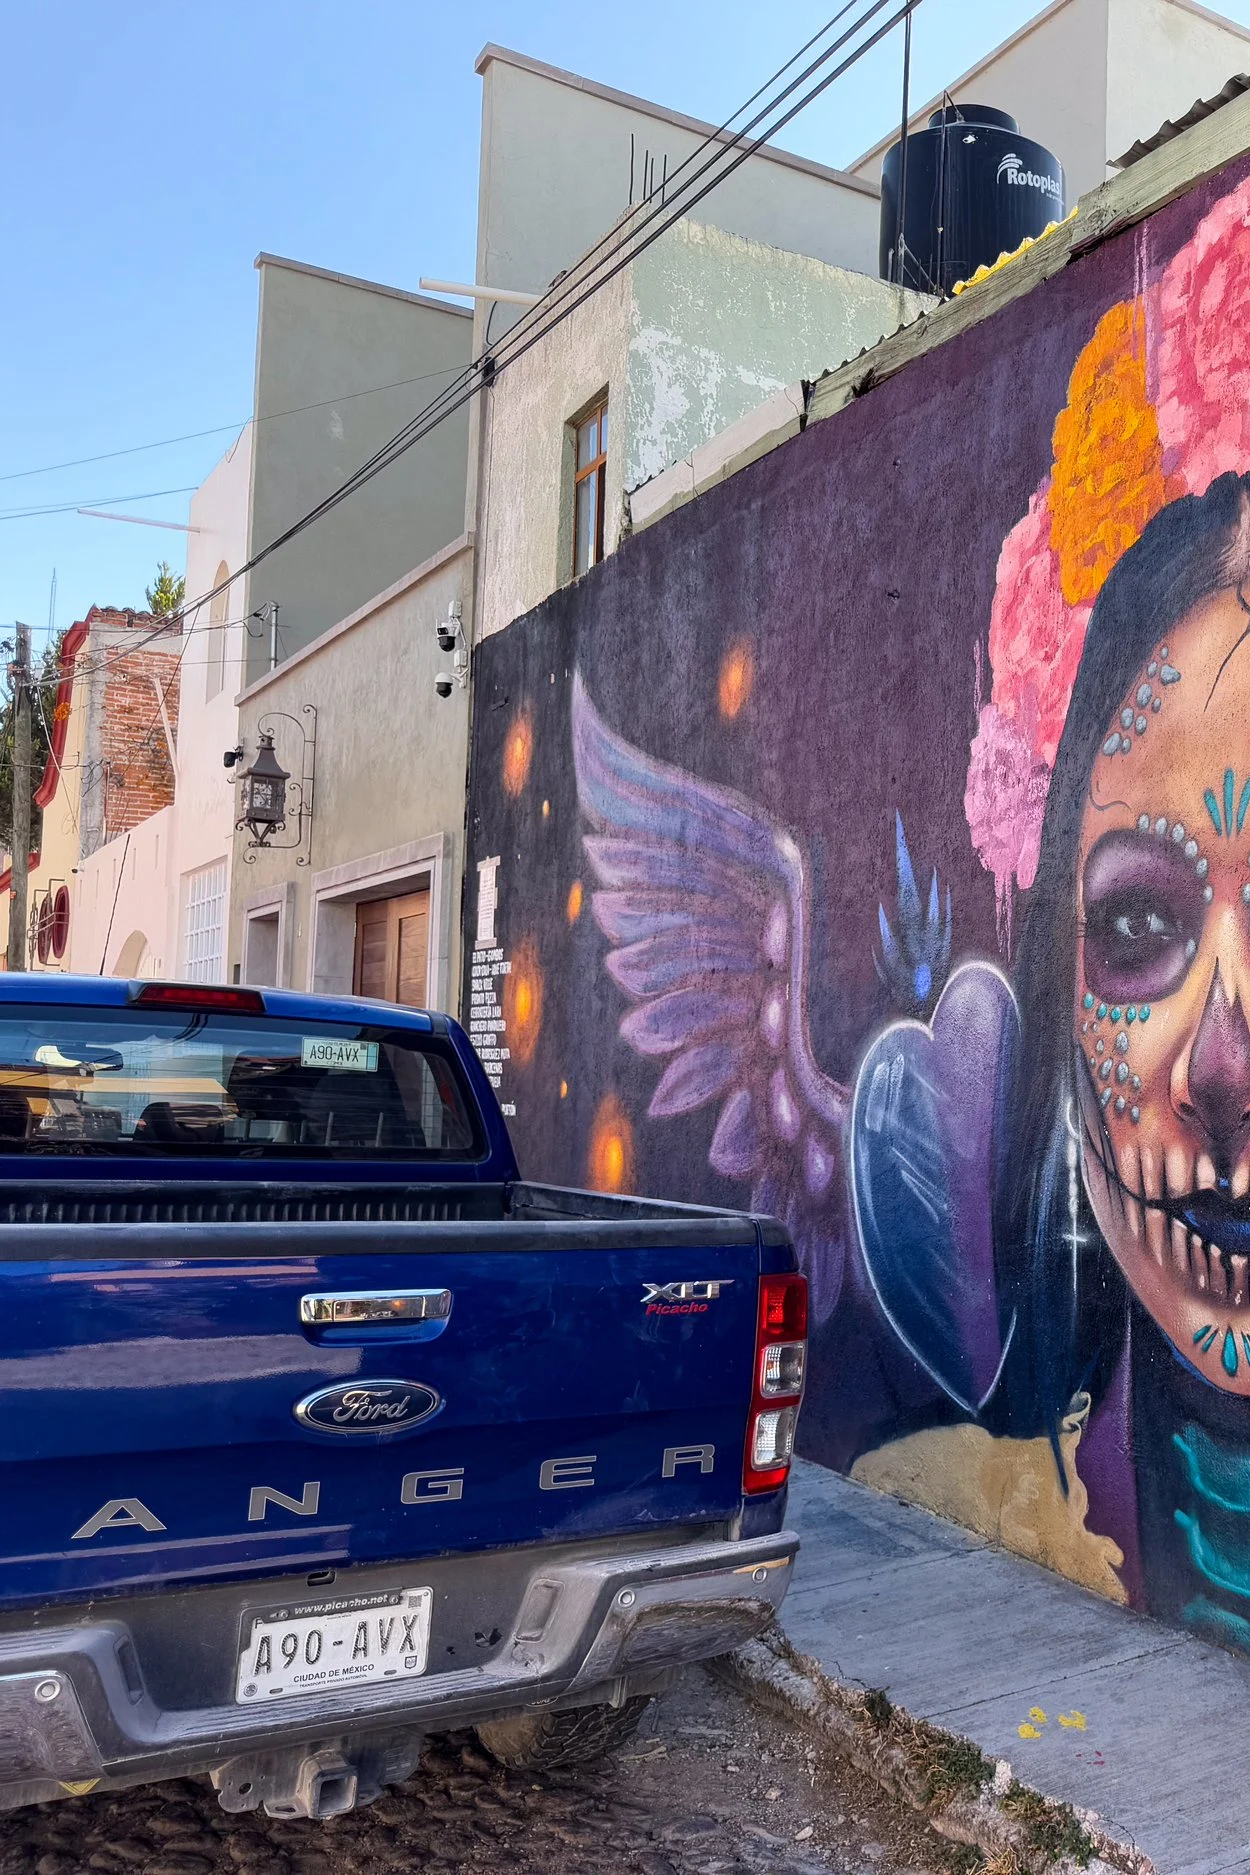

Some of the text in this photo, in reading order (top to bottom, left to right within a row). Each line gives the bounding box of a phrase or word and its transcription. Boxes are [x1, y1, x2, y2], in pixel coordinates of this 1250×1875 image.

[1007, 168, 1061, 195] Rotoplas
[310, 1045, 359, 1062] A90-AVX
[640, 1279, 735, 1303] XLT
[646, 1302, 709, 1316] Picacho
[332, 1390, 411, 1422] Ford
[252, 1612, 420, 1677] A90-AVX
[293, 1663, 375, 1683] CIUDAD DE MÉXICO
